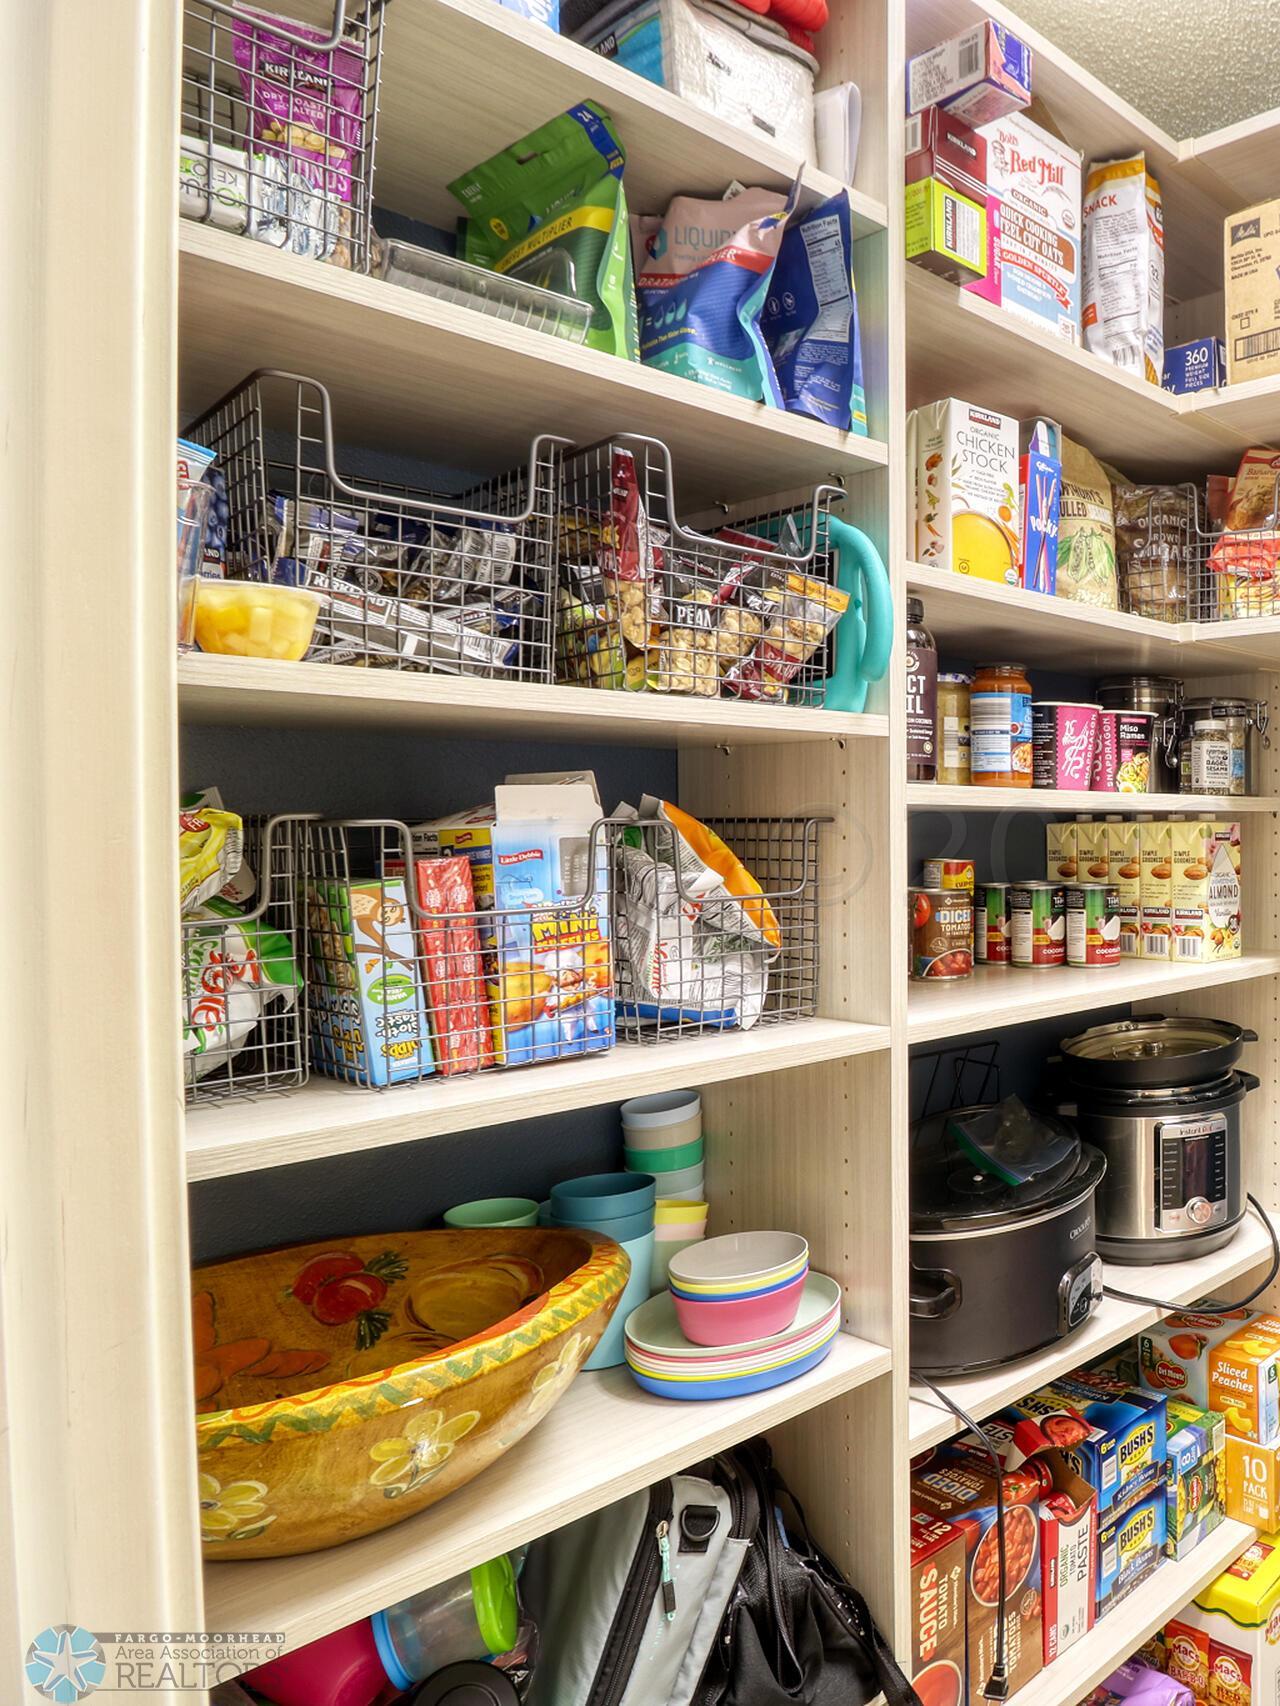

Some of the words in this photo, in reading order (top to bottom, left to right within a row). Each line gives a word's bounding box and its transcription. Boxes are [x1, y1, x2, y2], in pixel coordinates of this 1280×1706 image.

[262, 91, 283, 99] DRY
[293, 97, 337, 116] OASTD
[192, 164, 237, 186] KEO
[1010, 150, 1036, 175] Red
[1038, 158, 1064, 186] Mill
[1012, 189, 1048, 216] ORGANIC
[1083, 194, 1118, 218] SNACK
[945, 198, 954, 248] KIRKLAND
[1001, 203, 1024, 228] QUICK
[1025, 217, 1058, 248] COOKING
[1001, 219, 1022, 242] TEEL
[1023, 232, 1041, 252] CUT
[1042, 243, 1064, 266] OATS
[1185, 347, 1209, 366] 360
[956, 430, 1015, 459] CHICKEN
[970, 426, 1000, 441] ORGANIC
[962, 449, 1008, 474] STOCK
[1060, 480, 1105, 505] NTHONY'S
[1060, 500, 1088, 517] ULLED
[676, 606, 712, 628] PEAN
[907, 695, 924, 714] IL
[1120, 724, 1139, 733] Miso
[1120, 732, 1146, 740] Ramen
[1083, 713, 1097, 786] SNAPDRAGON
[1103, 717, 1113, 788] SNAPDRAGON
[1206, 759, 1228, 767] BAGEL
[423, 832, 438, 842] Facts
[518, 851, 541, 862] Debbie
[1209, 885, 1239, 900] ALMOND
[1143, 907, 1170, 915] KIRKLAND
[1176, 909, 1203, 917] KIRKLAND
[532, 911, 600, 939] MINI
[941, 923, 971, 932] TOMATO
[1143, 1338, 1150, 1348] 6
[1167, 1369, 1186, 1382] Monte
[1217, 1361, 1248, 1380] Sliced
[1269, 1366, 1276, 1377] 6
[1211, 1372, 1254, 1393] Peaches
[984, 1423, 1014, 1444] STE
[1119, 1424, 1154, 1463] BUSH'S
[1101, 1442, 1108, 1453] 6
[939, 1468, 985, 1491] TOMATOES
[1243, 1455, 1267, 1482] 10
[923, 1473, 977, 1501] DICED
[1243, 1481, 1267, 1500] PACK
[929, 1520, 952, 1535] 12
[1101, 1531, 1108, 1543] 6
[1119, 1510, 1154, 1549] BUSH'S
[1069, 1544, 1077, 1576] TOMATO
[1077, 1524, 1088, 1582] PASTE
[1060, 1544, 1069, 1588] ORGANIC
[1118, 1564, 1135, 1586] Black
[920, 1567, 938, 1659] SAUCE
[938, 1574, 948, 1631] TOMATO
[1008, 1611, 1017, 1674] TOMATOES
[1049, 1624, 1057, 1647] CANS
